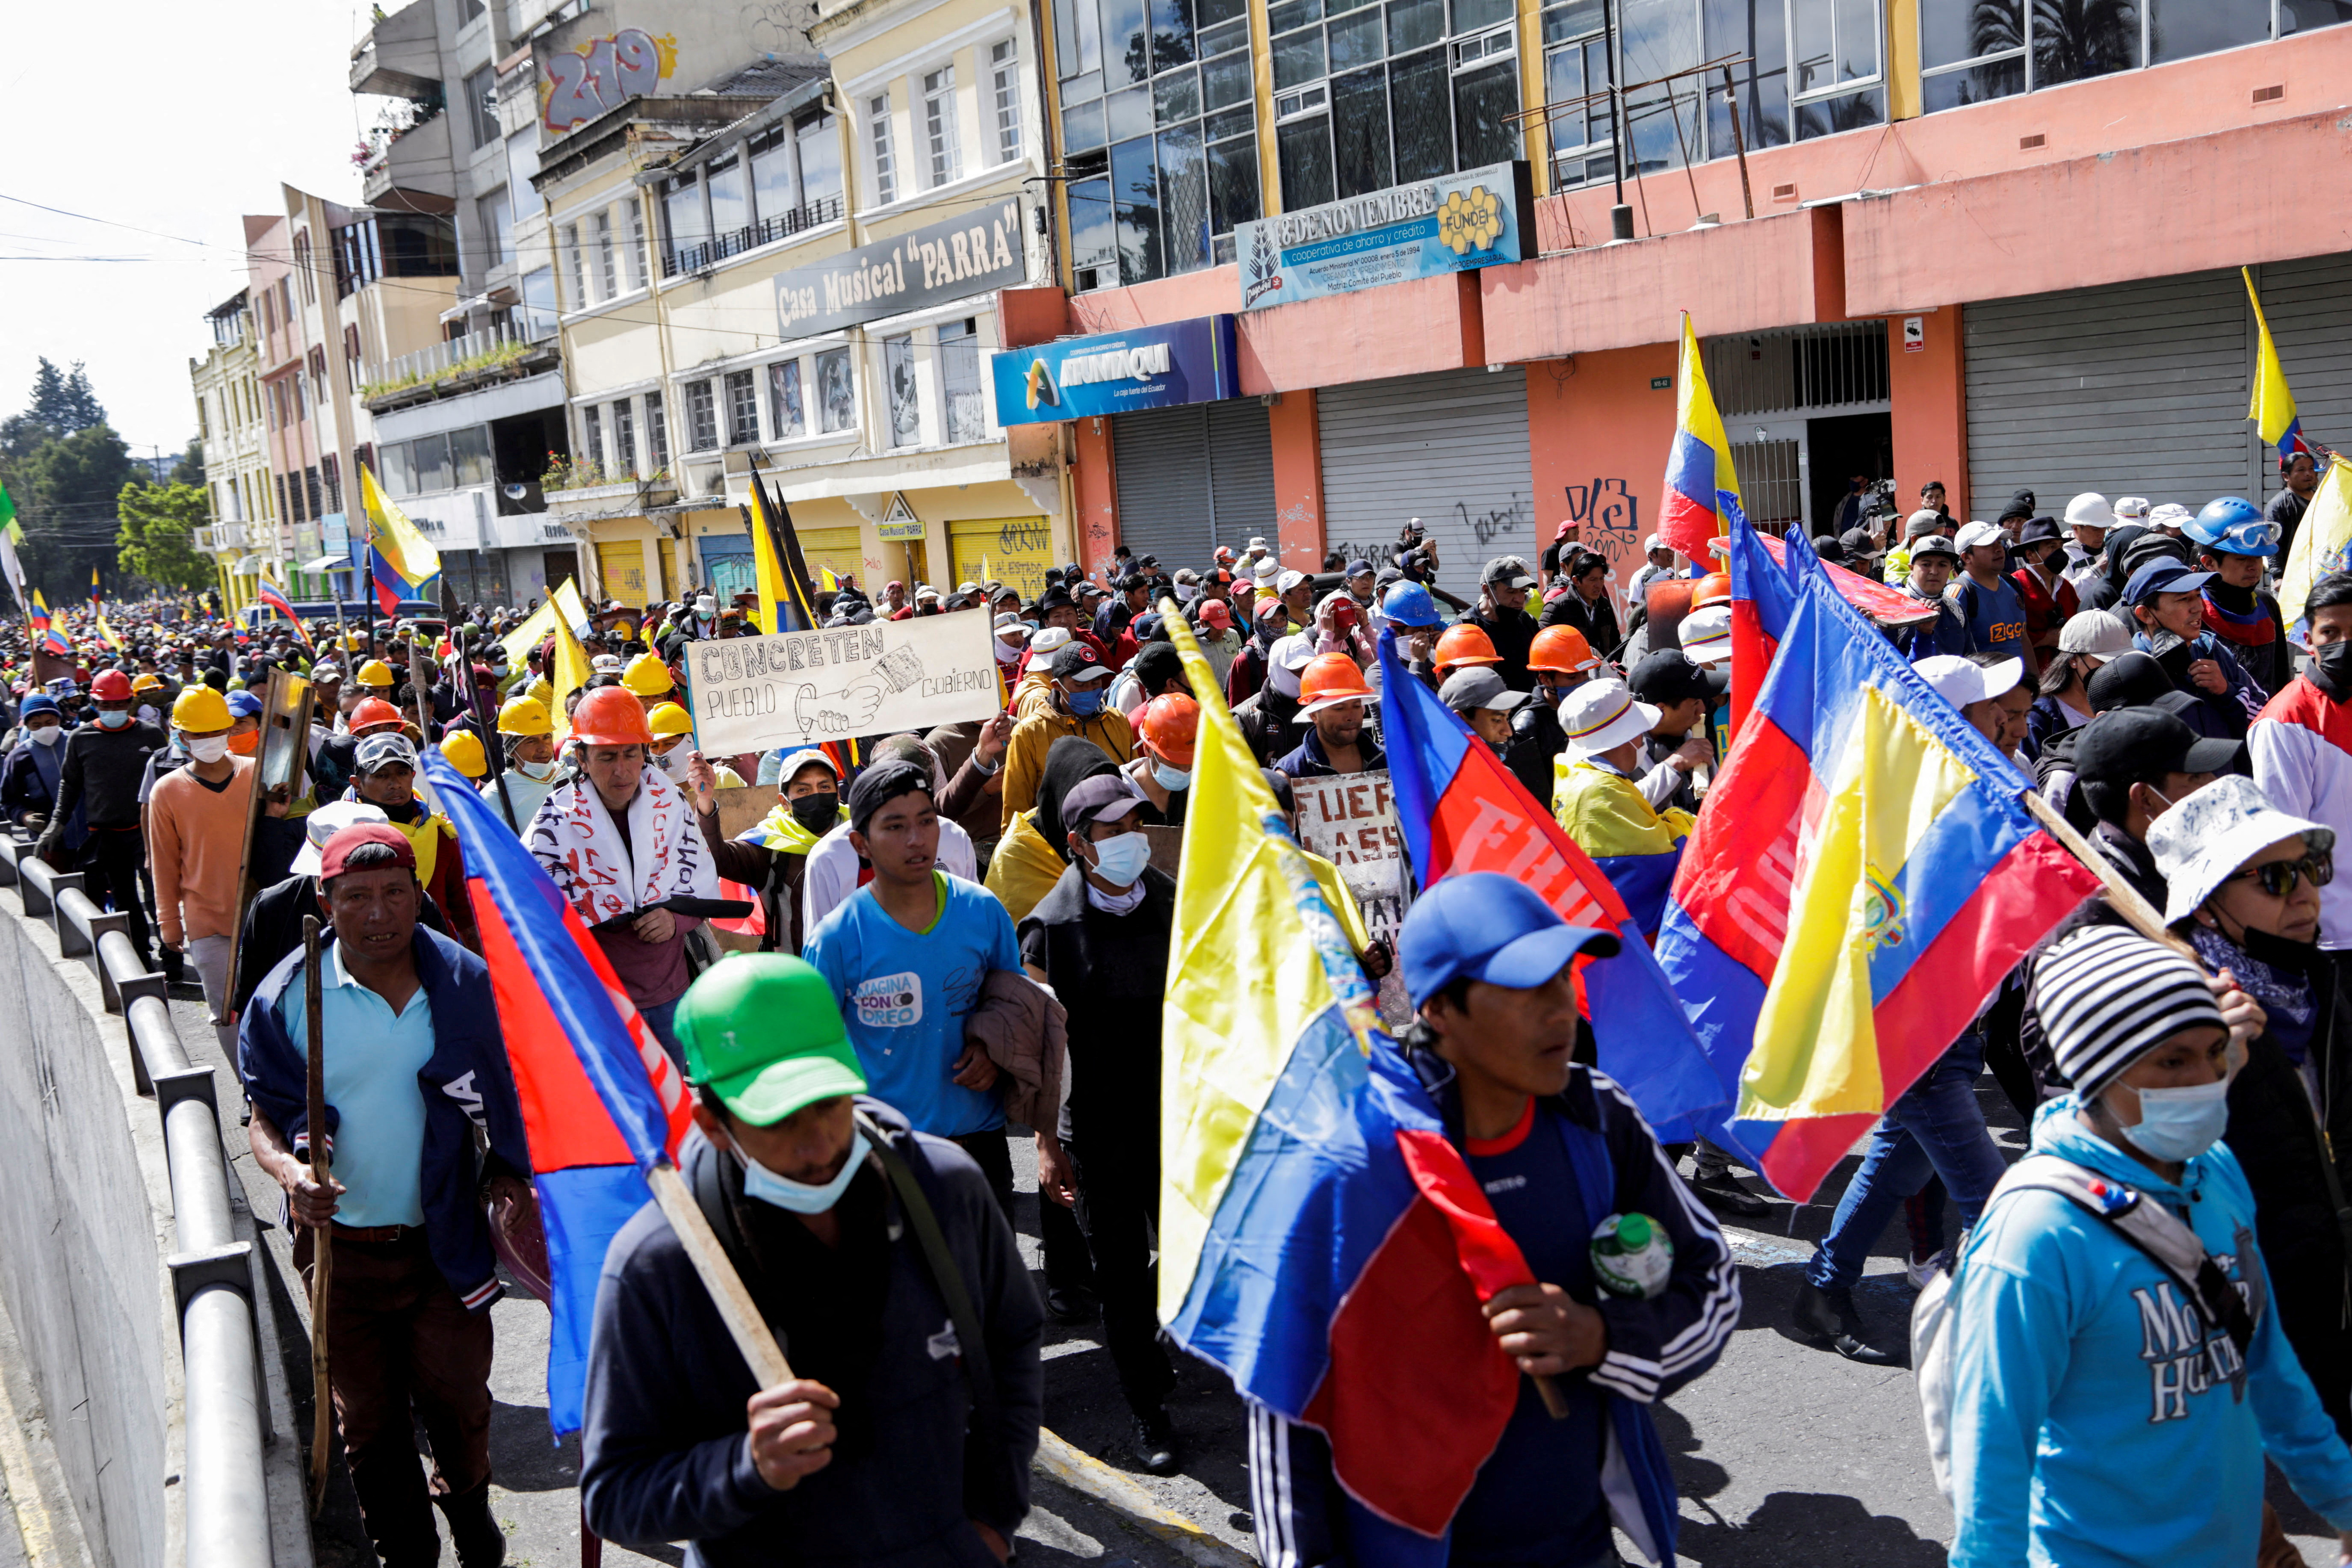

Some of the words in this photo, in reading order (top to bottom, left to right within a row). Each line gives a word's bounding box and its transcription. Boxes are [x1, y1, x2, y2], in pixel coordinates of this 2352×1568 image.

[1440, 176, 1460, 186] FUNDACIÓN
[1460, 174, 1470, 182] PARA
[1475, 168, 1498, 177] DESARROLLO
[1273, 218, 1292, 247] 18
[1293, 214, 1319, 243] DE
[1321, 184, 1435, 236] NOVIEMBRE
[1446, 209, 1489, 231] FUNDEI
[1291, 239, 1341, 263] cooperativa
[1342, 240, 1354, 250] de
[1356, 233, 1384, 248] ahorro
[1386, 231, 1392, 245] y
[1393, 225, 1425, 240] crédito
[1309, 265, 1329, 275] Acuerdo
[1329, 259, 1354, 271] Ministerial
[1361, 255, 1380, 265] 00008,
[1380, 253, 1395, 261] enero
[1400, 249, 1406, 257] de
[1406, 246, 1421, 256] 1994
[1448, 254, 1506, 270] MICROEMPRESARIAL
[778, 285, 817, 328] Casa
[823, 246, 905, 316] Musical
[1328, 282, 1349, 292] Matriz:
[1348, 277, 1369, 288] Comité
[1370, 275, 1380, 284] del
[1380, 270, 1402, 282] Pueblo
[1070, 348, 1090, 356] COOPERATIVA
[1059, 343, 1170, 387] ATUNTAQUI
[1120, 389, 1129, 398] caja
[1129, 387, 1141, 396] fuerte
[1148, 383, 1166, 392] Ecuador
[879, 527, 889, 536] Casa
[889, 526, 905, 535] Musical
[1008, 561, 1043, 576] ESTADO
[702, 628, 883, 684] CONCRETEN
[706, 684, 775, 720] PUEBLO
[861, 996, 890, 1008] CON
[862, 1007, 913, 1025] OREO
